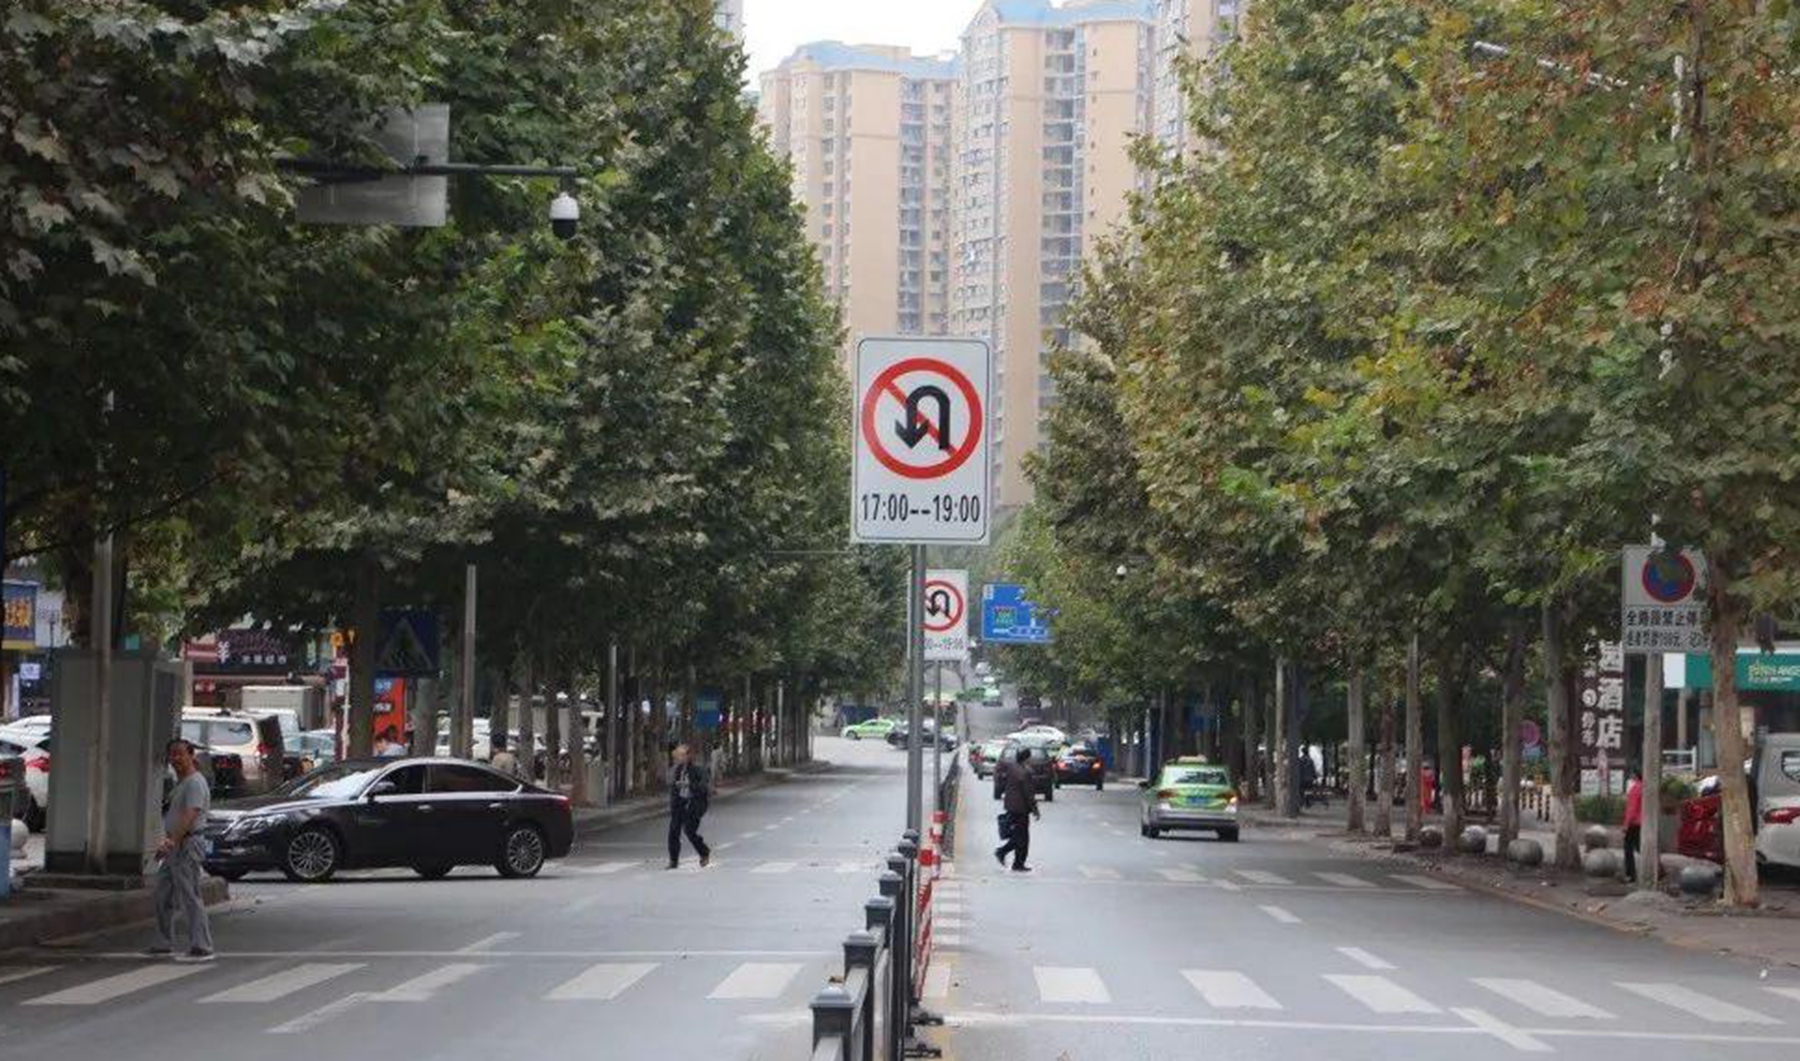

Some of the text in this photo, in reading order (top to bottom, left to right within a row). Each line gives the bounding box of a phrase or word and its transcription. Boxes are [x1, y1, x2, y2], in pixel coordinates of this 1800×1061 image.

[862, 494, 980, 522] 17:00--19:00
[1627, 610, 1708, 627] 全路段禁止停
